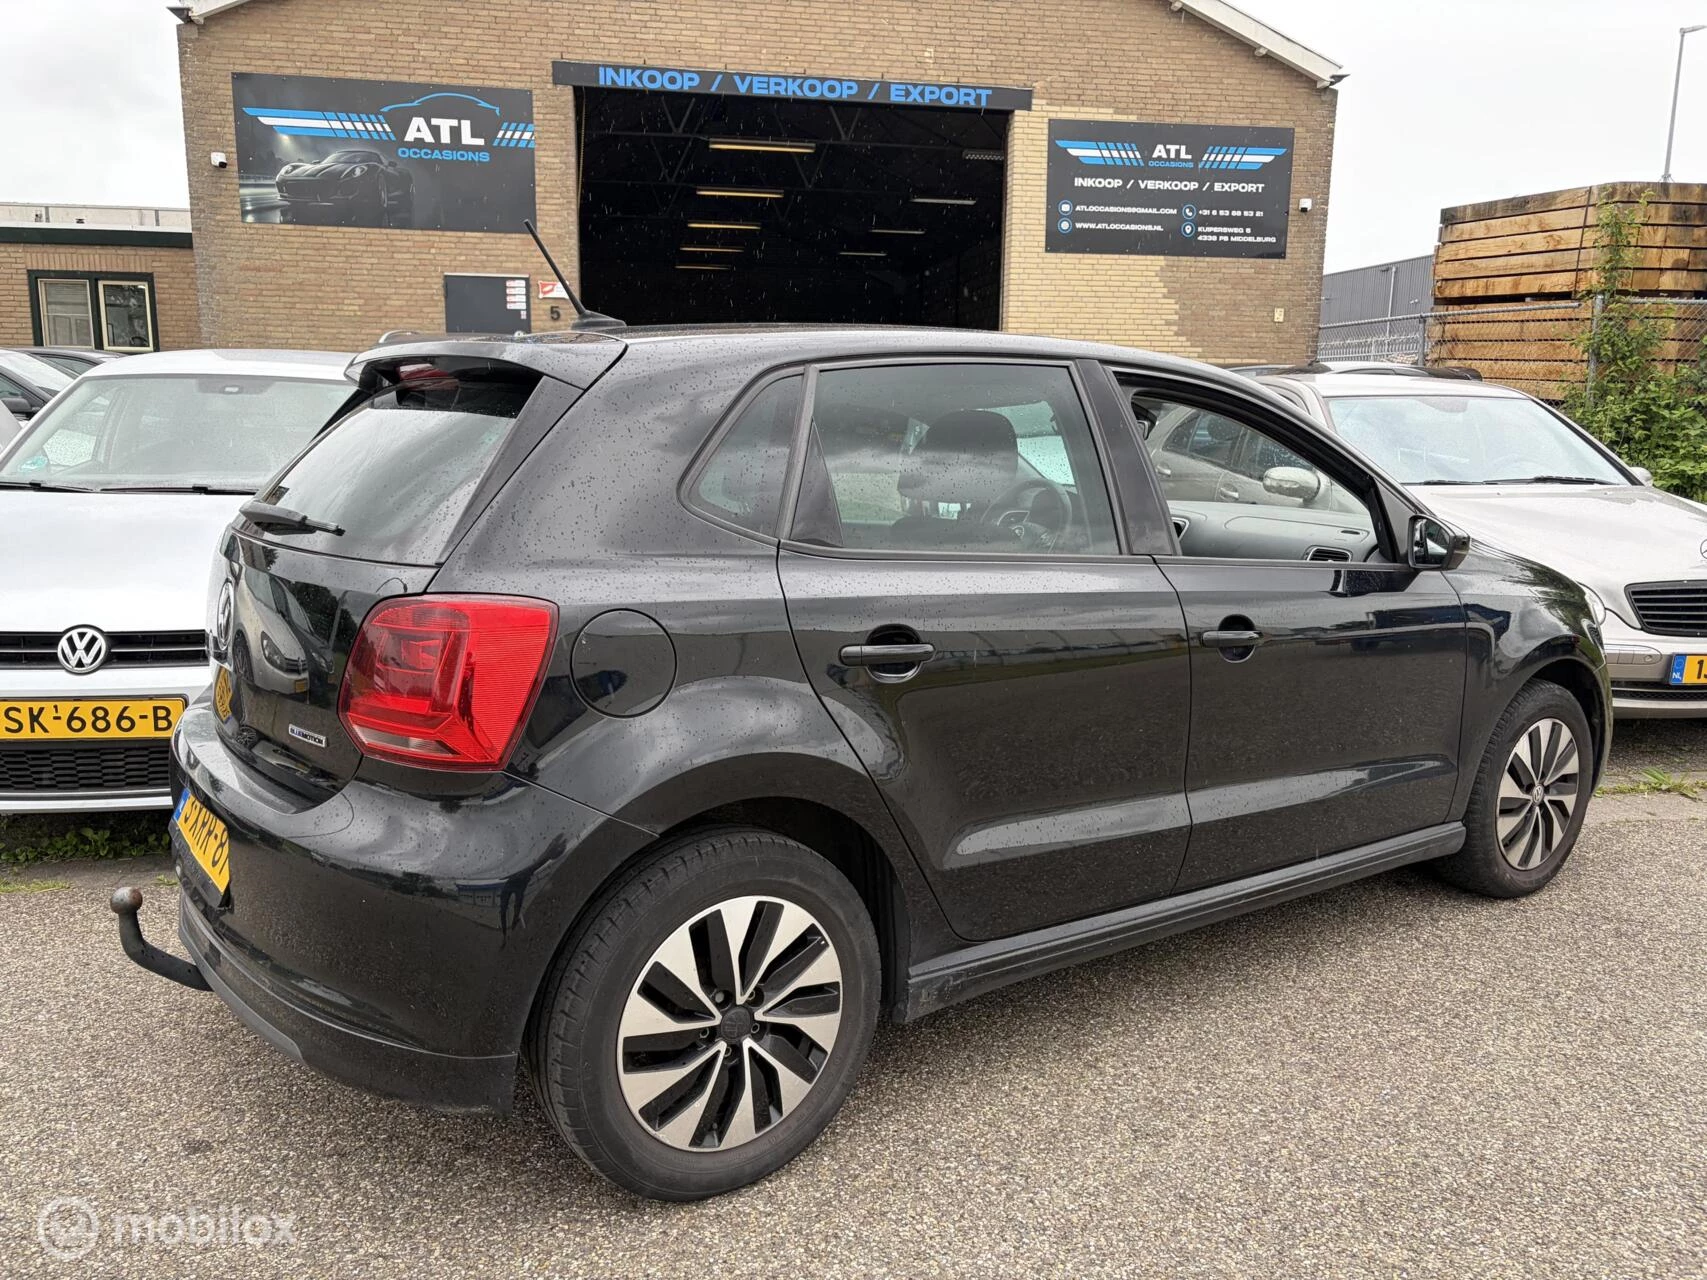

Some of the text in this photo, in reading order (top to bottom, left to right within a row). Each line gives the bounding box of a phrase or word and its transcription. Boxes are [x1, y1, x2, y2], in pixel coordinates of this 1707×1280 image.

[599, 66, 993, 106] INKOOP / VERKOOP / EXPORT
[404, 116, 485, 146] ATL
[398, 147, 491, 162] OCCASIONS
[1151, 143, 1193, 159] ATL
[1148, 160, 1194, 168] OCCASIONS
[1074, 177, 1265, 193] INKOOP / VERKOOP / EXPORT
[1075, 222, 1164, 231] WWW.ATLOCCASIONS.NL
[550, 305, 561, 321] 5
